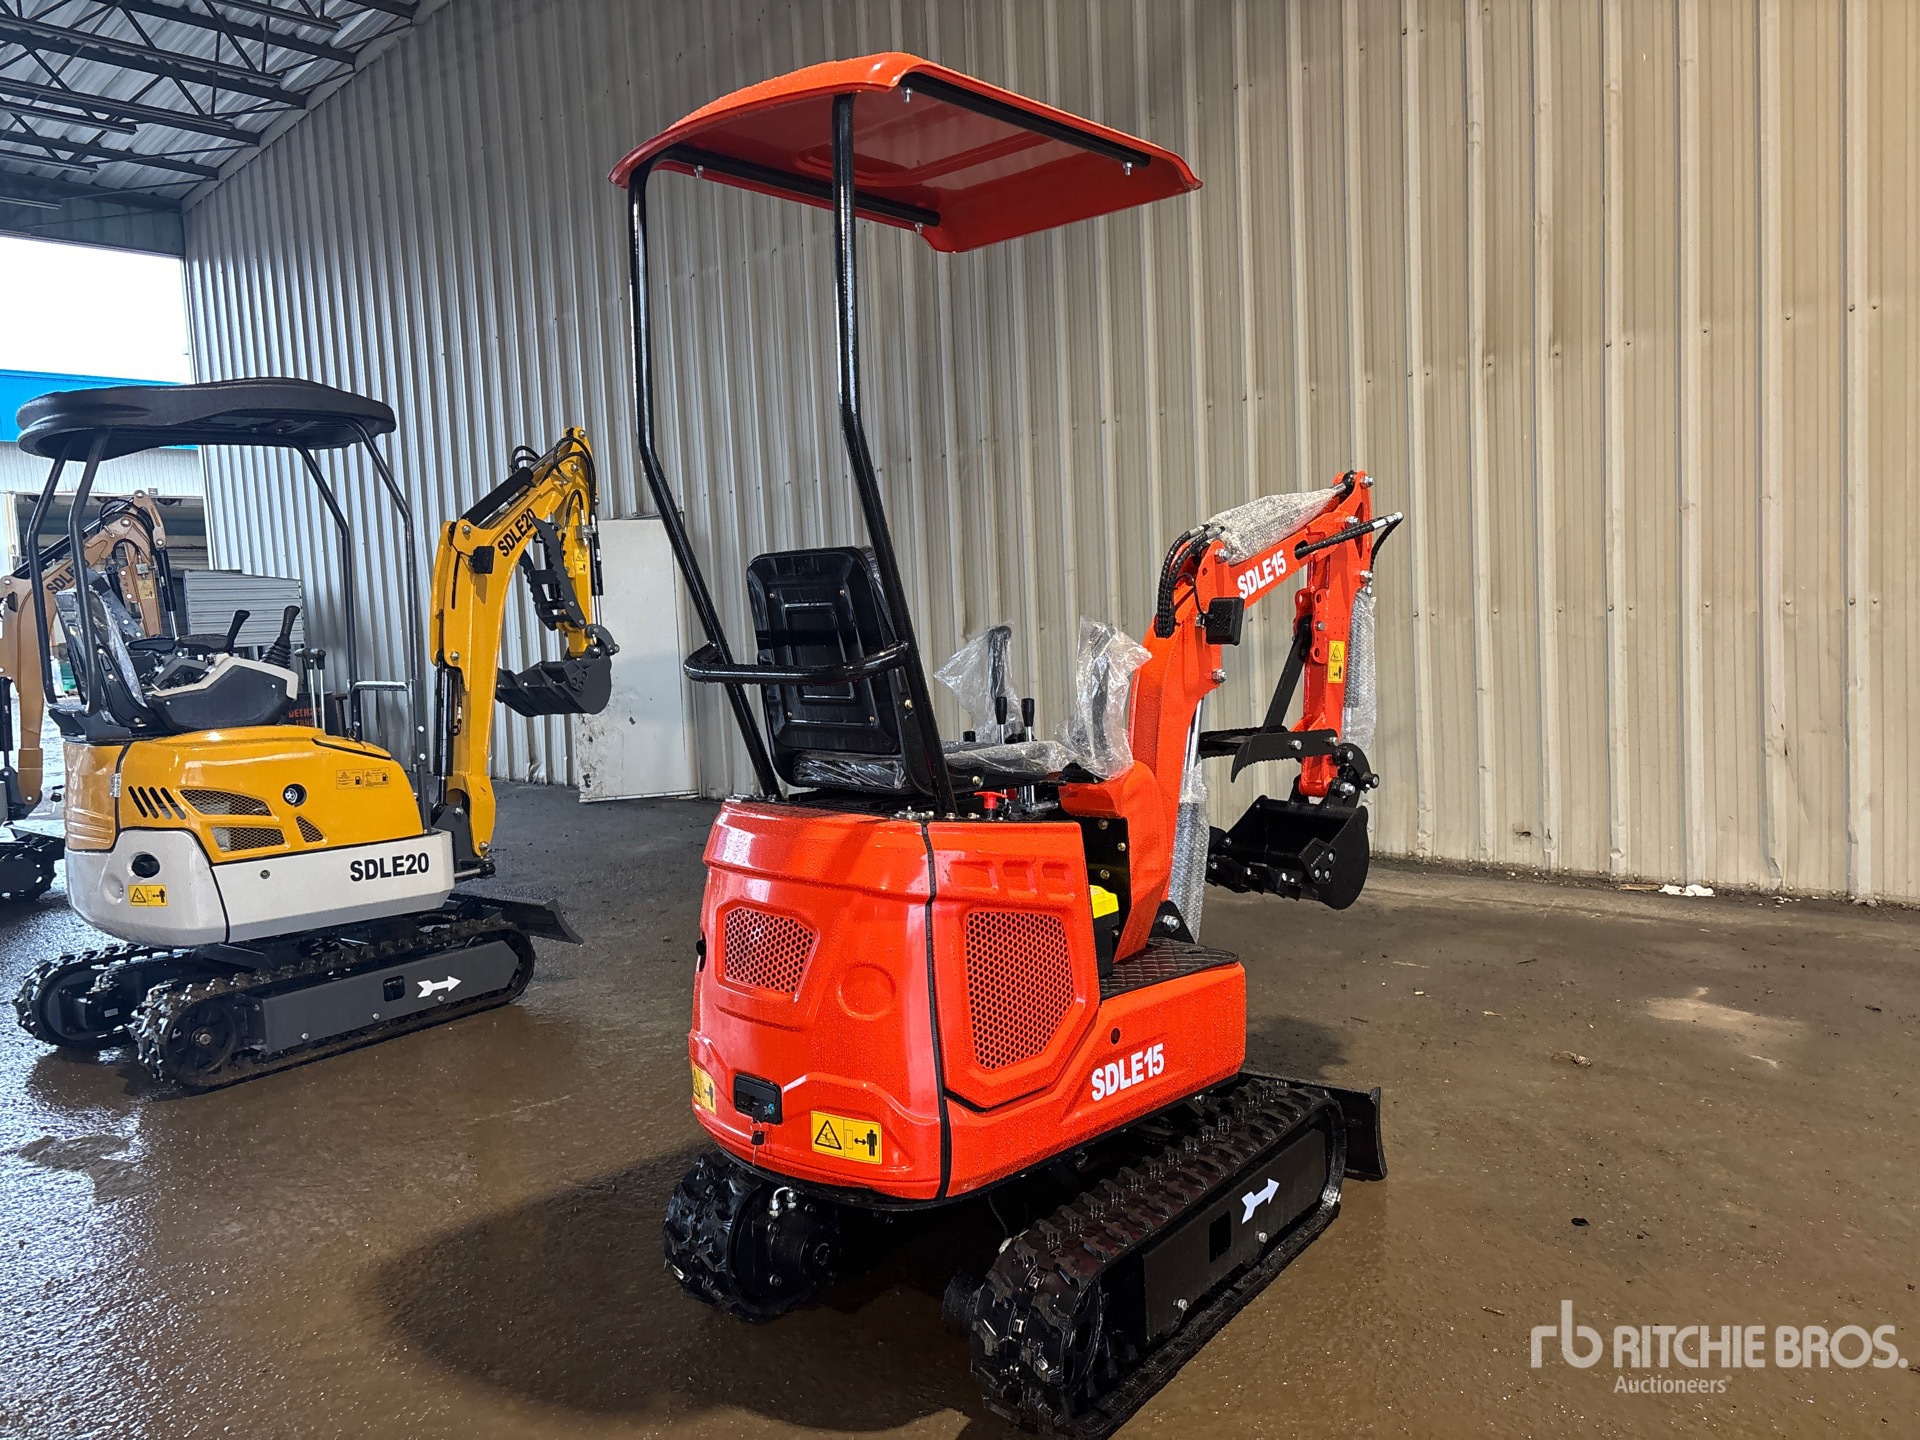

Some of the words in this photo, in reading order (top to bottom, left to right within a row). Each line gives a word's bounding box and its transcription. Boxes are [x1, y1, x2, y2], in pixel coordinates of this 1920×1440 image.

[1237, 549, 1287, 600] SDLE15
[350, 852, 430, 882] SDLE20
[1091, 1043, 1165, 1102] SDLE15
